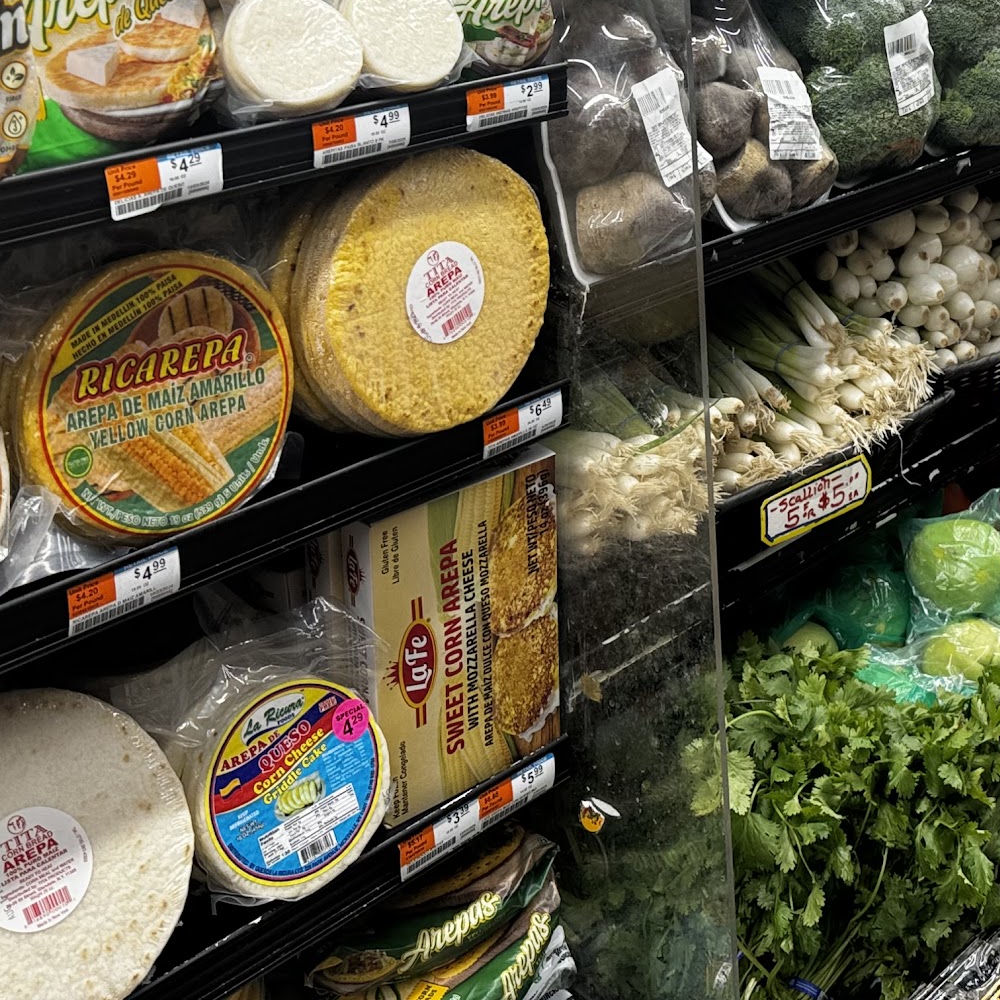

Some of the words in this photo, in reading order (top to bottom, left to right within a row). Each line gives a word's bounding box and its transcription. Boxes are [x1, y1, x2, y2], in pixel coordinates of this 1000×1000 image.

[115, 9, 132, 36] de
[324, 124, 344, 134] $4.20
[114, 170, 137, 183] $4.29
[123, 179, 143, 188] Pound
[423, 256, 454, 282] TITA
[427, 266, 462, 298] AREPA
[70, 331, 92, 349] MADE
[91, 325, 101, 335] IN
[101, 302, 136, 329] MEDELLIN
[136, 288, 157, 304] 100%
[156, 273, 177, 291] PAISA
[72, 340, 98, 360] HECHO
[97, 333, 108, 344] EN
[108, 308, 142, 335] MEDELLÍN
[143, 295, 163, 311] 100%
[162, 281, 184, 298] PAISA
[78, 333, 245, 400] RICAREPA
[66, 404, 118, 432] AREPA
[123, 396, 143, 415] DE
[147, 384, 185, 411] MAÍZ
[190, 367, 265, 404] AMARILLO
[89, 422, 149, 451] YELLOW
[155, 410, 195, 434] CORN
[200, 395, 246, 423] AREPA
[141, 515, 168, 527] NETO
[170, 515, 181, 526] 19
[181, 512, 194, 522] oz
[230, 468, 251, 494] Units
[525, 473, 537, 503] NETO
[784, 506, 800, 528] 5
[380, 530, 388, 548] Free
[391, 526, 400, 552] Gluten
[478, 519, 490, 585] MOZZARELLA
[381, 548, 390, 575] Gluten
[391, 552, 400, 563] de
[527, 554, 540, 575] NET
[392, 564, 400, 585] Libre
[439, 538, 461, 613] AREPA
[461, 548, 476, 603] CHEESE
[75, 587, 99, 602] $4.20
[84, 594, 104, 607] Pound
[480, 587, 492, 623] QUESO
[444, 616, 464, 678] CORN
[464, 604, 479, 692] MOZZARELLA
[481, 623, 492, 642] CON
[405, 635, 432, 692] LaFe
[482, 643, 493, 676] DULCE
[480, 675, 493, 703] MAÍZ
[244, 718, 262, 739] La
[264, 696, 304, 722] Ricura
[277, 713, 295, 726] FOODS
[335, 702, 365, 721] SPECIAL
[445, 682, 465, 755] SWEET
[467, 693, 480, 731] WITH
[483, 703, 494, 716] DE
[258, 719, 312, 775] QUESO
[484, 716, 494, 747] AREPA
[221, 738, 269, 772] AREPA
[269, 730, 281, 743] DE
[253, 768, 286, 795] Corn
[284, 727, 325, 767] Cheese
[400, 740, 409, 777] Congelado
[263, 766, 303, 805] Griddle
[302, 742, 328, 768] Cake
[392, 801, 401, 820] Keep
[400, 777, 409, 816] Mantener
[0, 824, 48, 853] TITA
[1, 846, 24, 861] CORN
[26, 830, 54, 851] BREAD
[3, 837, 59, 874] AREPA
[20, 866, 36, 878] PARA
[36, 848, 68, 868] CALENTAR
[24, 856, 42, 869] PURO
[43, 846, 60, 860] MAIZ
[397, 891, 502, 975] Arepas
[500, 911, 551, 1000] Arepas
